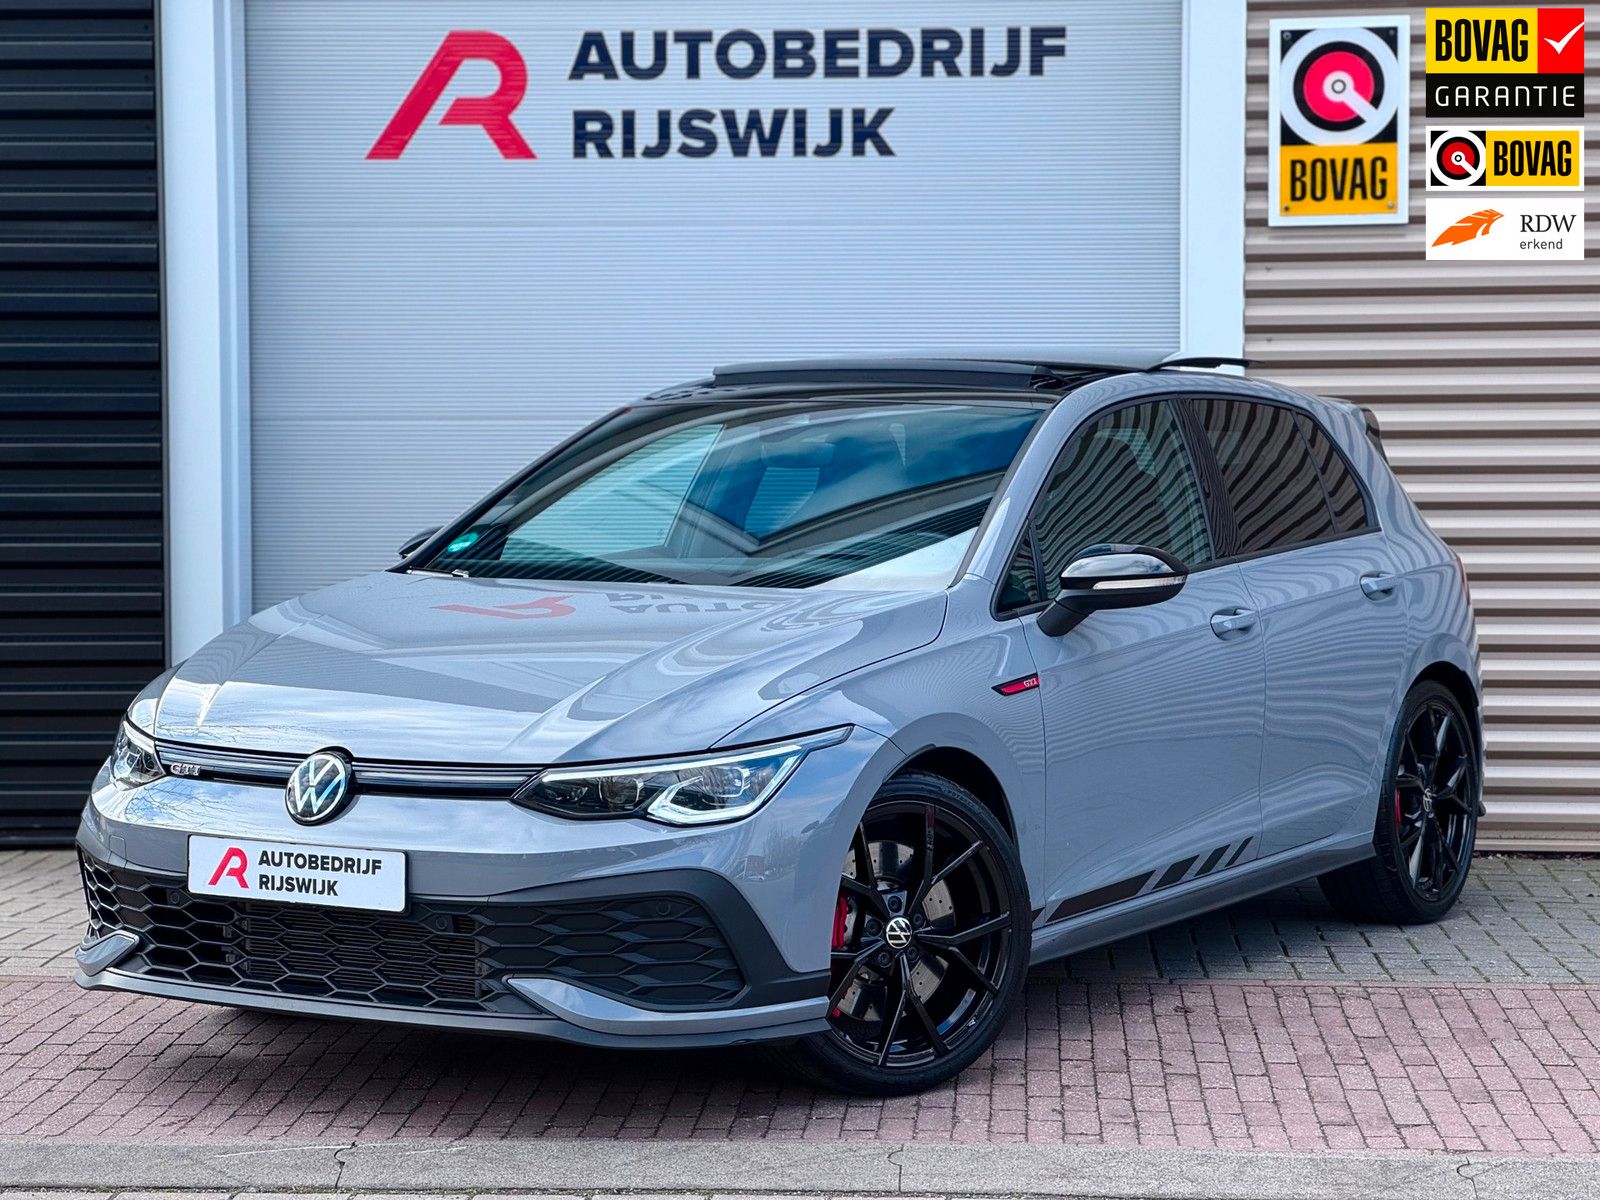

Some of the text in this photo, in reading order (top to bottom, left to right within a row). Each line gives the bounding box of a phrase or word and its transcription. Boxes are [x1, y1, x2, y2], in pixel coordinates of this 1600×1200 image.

[568, 26, 1067, 80] AUTOBEDRIJF
[572, 107, 896, 159] RIJSWIJK
[1290, 156, 1388, 202] BOVAG
[170, 762, 200, 776] GTI
[258, 850, 382, 875] AUTOBEDRIJF
[259, 873, 338, 896] RIJSWIJK
